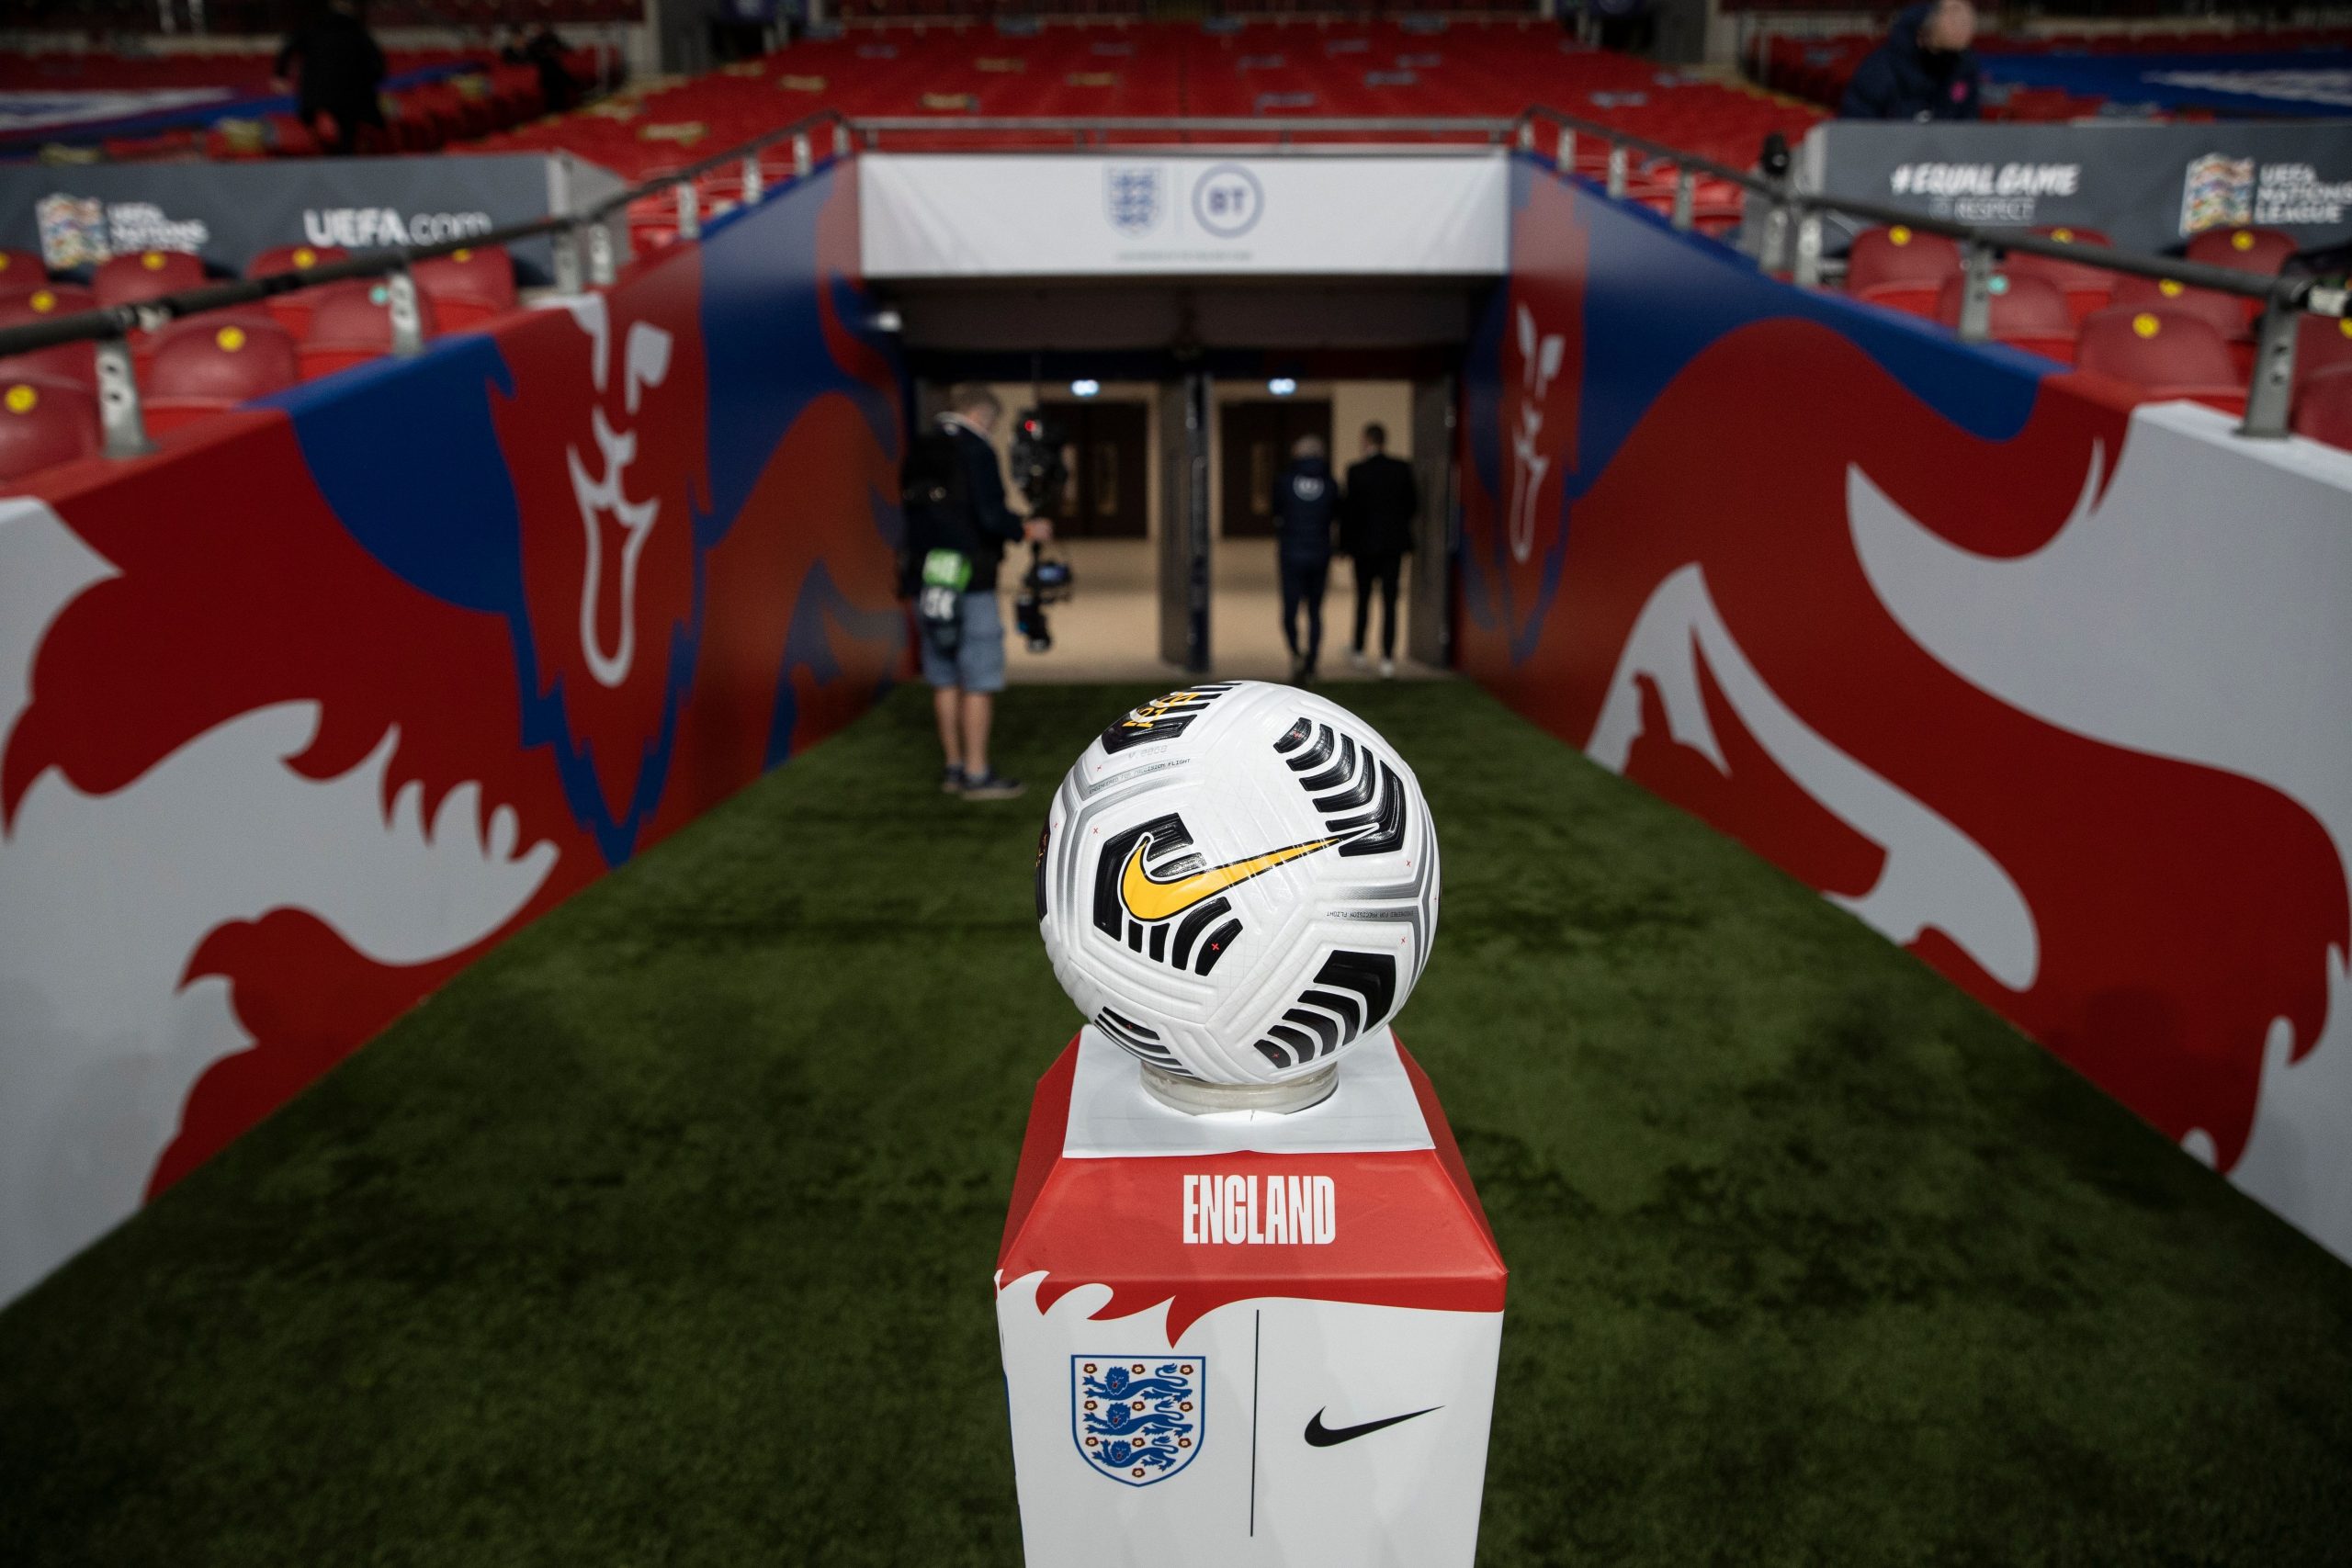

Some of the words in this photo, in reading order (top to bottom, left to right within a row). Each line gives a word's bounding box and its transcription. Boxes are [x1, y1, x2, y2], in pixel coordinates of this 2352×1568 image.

[1208, 186, 1246, 215] BT
[303, 208, 492, 247] UEFA.com
[1168, 758, 1191, 767] FLIGHT
[1183, 1175, 1336, 1245] ENGLAND
